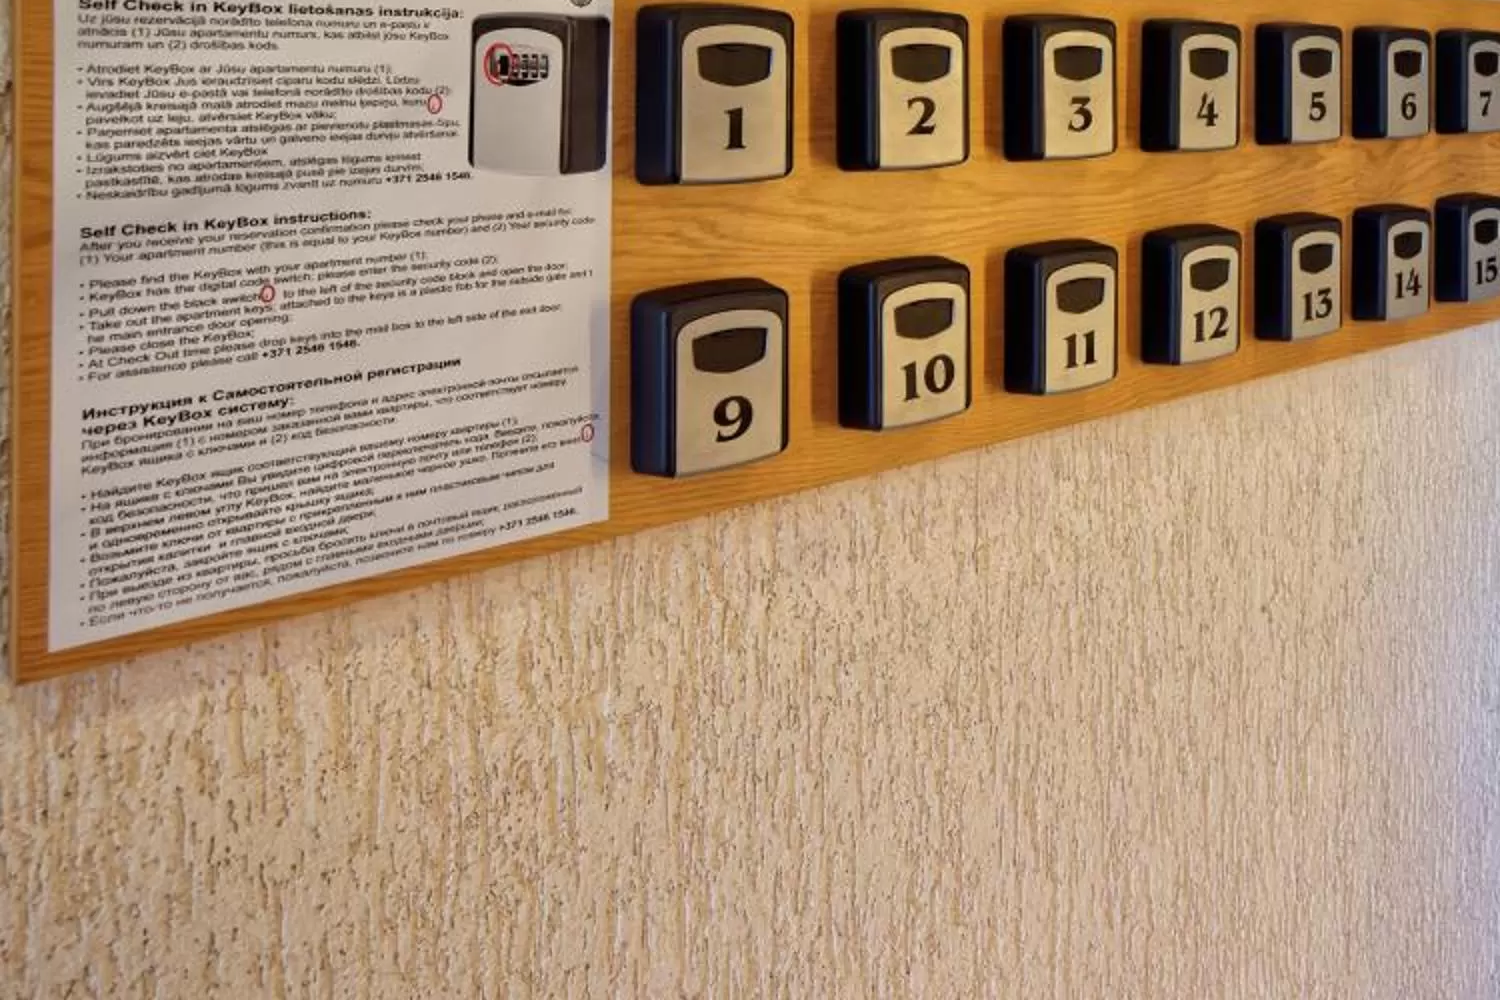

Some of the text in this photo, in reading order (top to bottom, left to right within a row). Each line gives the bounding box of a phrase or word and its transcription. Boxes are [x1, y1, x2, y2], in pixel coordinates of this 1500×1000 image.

[122, 0, 182, 11] Check
[190, 2, 206, 12] in
[213, 1, 282, 15] KeyBox
[118, 76, 169, 88] KeyBox
[144, 64, 194, 75] KeyBox
[906, 96, 936, 136] 2
[1066, 96, 1093, 133] 3
[1195, 92, 1219, 127] 4
[1308, 91, 1327, 122] 5
[1400, 92, 1417, 121] 6
[1478, 90, 1493, 117] 7
[724, 107, 746, 151] 1
[80, 211, 370, 238] Self Check in KeyBox instructions:
[79, 242, 112, 251] After
[117, 241, 141, 250] you
[198, 234, 225, 245] your
[103, 253, 133, 262] Your
[137, 247, 205, 260] apartment
[208, 243, 256, 253] number
[352, 234, 375, 244] your
[89, 278, 136, 288] Please
[140, 274, 164, 283] find
[168, 272, 189, 281] the
[193, 268, 241, 280] KeyBox
[245, 265, 270, 274] with
[274, 263, 300, 274] your
[303, 257, 362, 270] apartment
[1394, 267, 1423, 299] 14
[1474, 255, 1499, 286] 15
[89, 289, 141, 302] KeyBox
[146, 287, 170, 295] has
[174, 284, 195, 293] the
[198, 279, 236, 292] digital
[283, 289, 294, 298] to
[297, 288, 316, 296] the
[319, 284, 337, 294] left
[340, 283, 351, 292] of
[1302, 287, 1333, 321] 13
[88, 307, 114, 317] Pull
[118, 304, 155, 314] down
[159, 302, 180, 310] the
[183, 297, 216, 308] black
[89, 320, 121, 330] Take
[125, 316, 147, 326] out
[151, 315, 171, 324] the
[175, 307, 240, 322] apartment
[333, 296, 345, 304] to
[347, 294, 366, 302] the
[109, 330, 142, 340] main
[146, 324, 203, 336] entrance
[1192, 306, 1229, 343] 12
[88, 336, 199, 354] Please close the
[88, 359, 103, 368] At
[107, 353, 149, 366] Check
[154, 349, 178, 360] Out
[213, 342, 255, 355] please
[1063, 329, 1097, 369] 11
[87, 371, 111, 380] For
[262, 347, 290, 357] +371
[901, 353, 955, 402] 10
[82, 397, 192, 420] Инструкция
[212, 370, 362, 400] Самостоятельной
[367, 359, 460, 381] регистрации
[82, 420, 136, 435] через
[143, 409, 211, 426] KeyBox
[712, 395, 754, 443] 9
